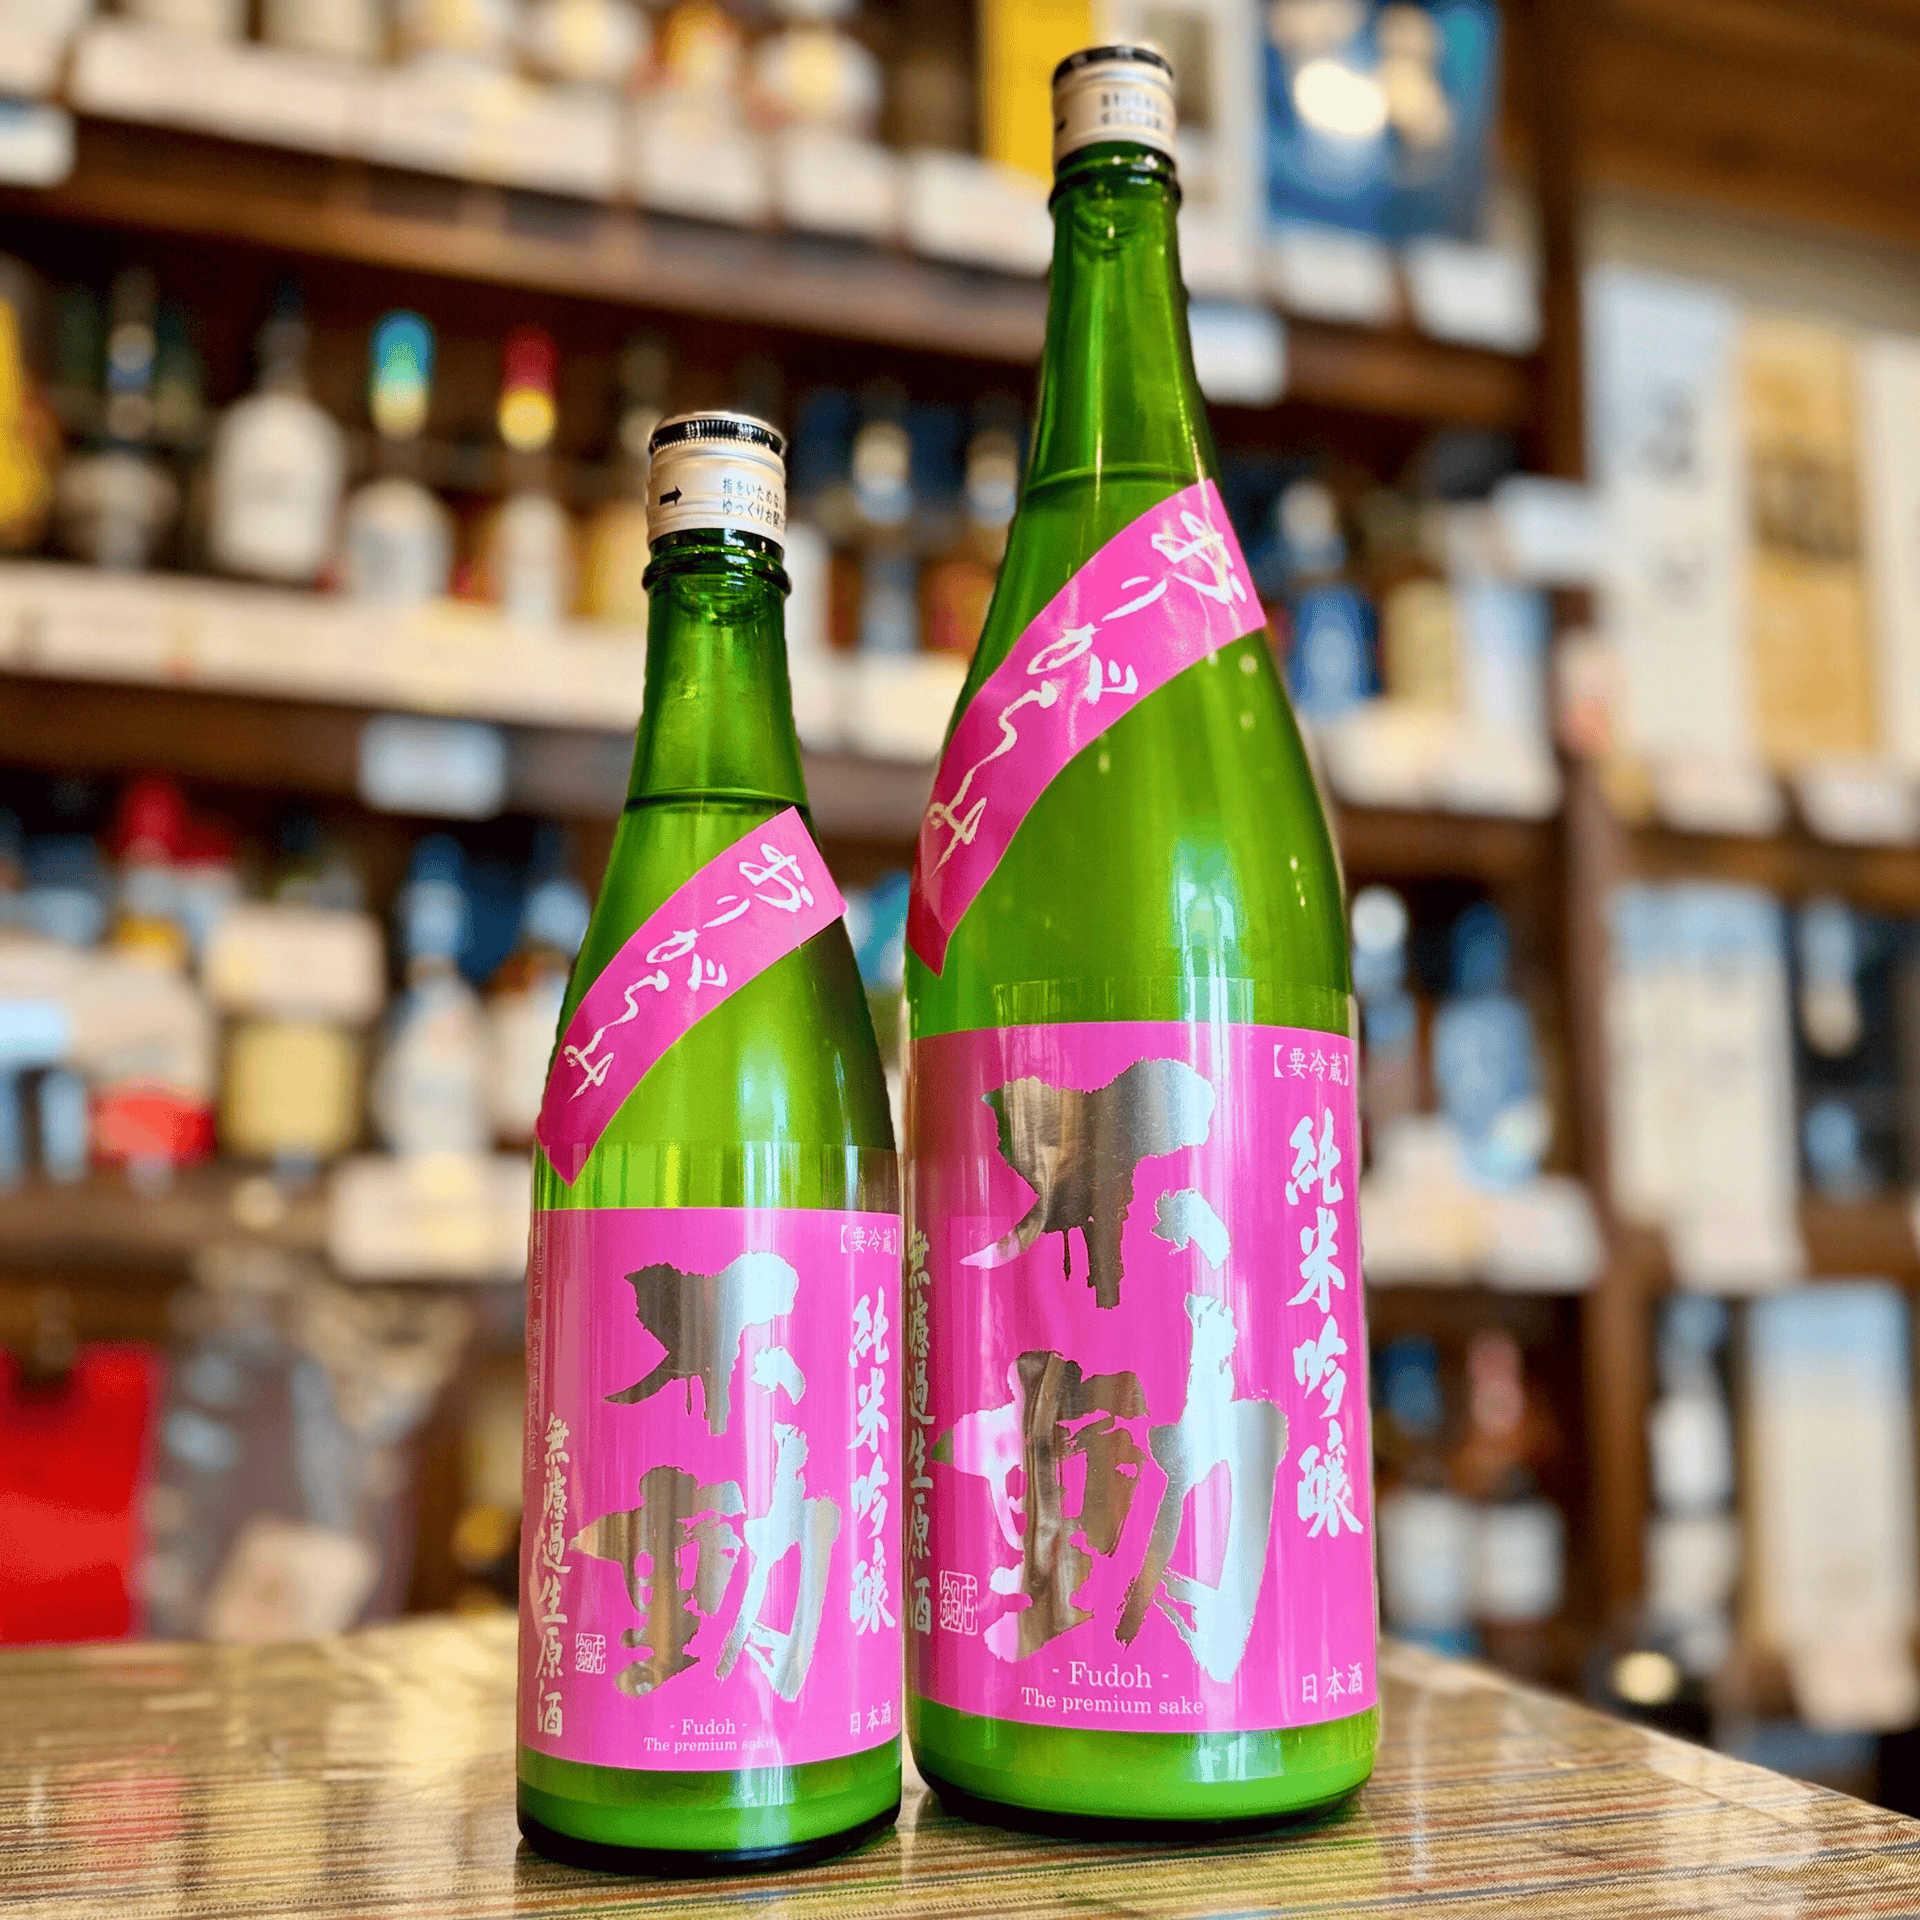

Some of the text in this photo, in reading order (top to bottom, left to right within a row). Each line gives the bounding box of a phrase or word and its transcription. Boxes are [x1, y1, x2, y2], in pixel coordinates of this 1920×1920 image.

[1069, 1661, 1153, 1689] Fudoh
[1302, 1663, 1364, 1704] 日本酒
[1021, 1688, 1204, 1715] The premium sake
[681, 1719, 737, 1735] Fudoh
[850, 1700, 892, 1735] 日本酒
[644, 1737, 671, 1752] The
[674, 1739, 738, 1754] premium
